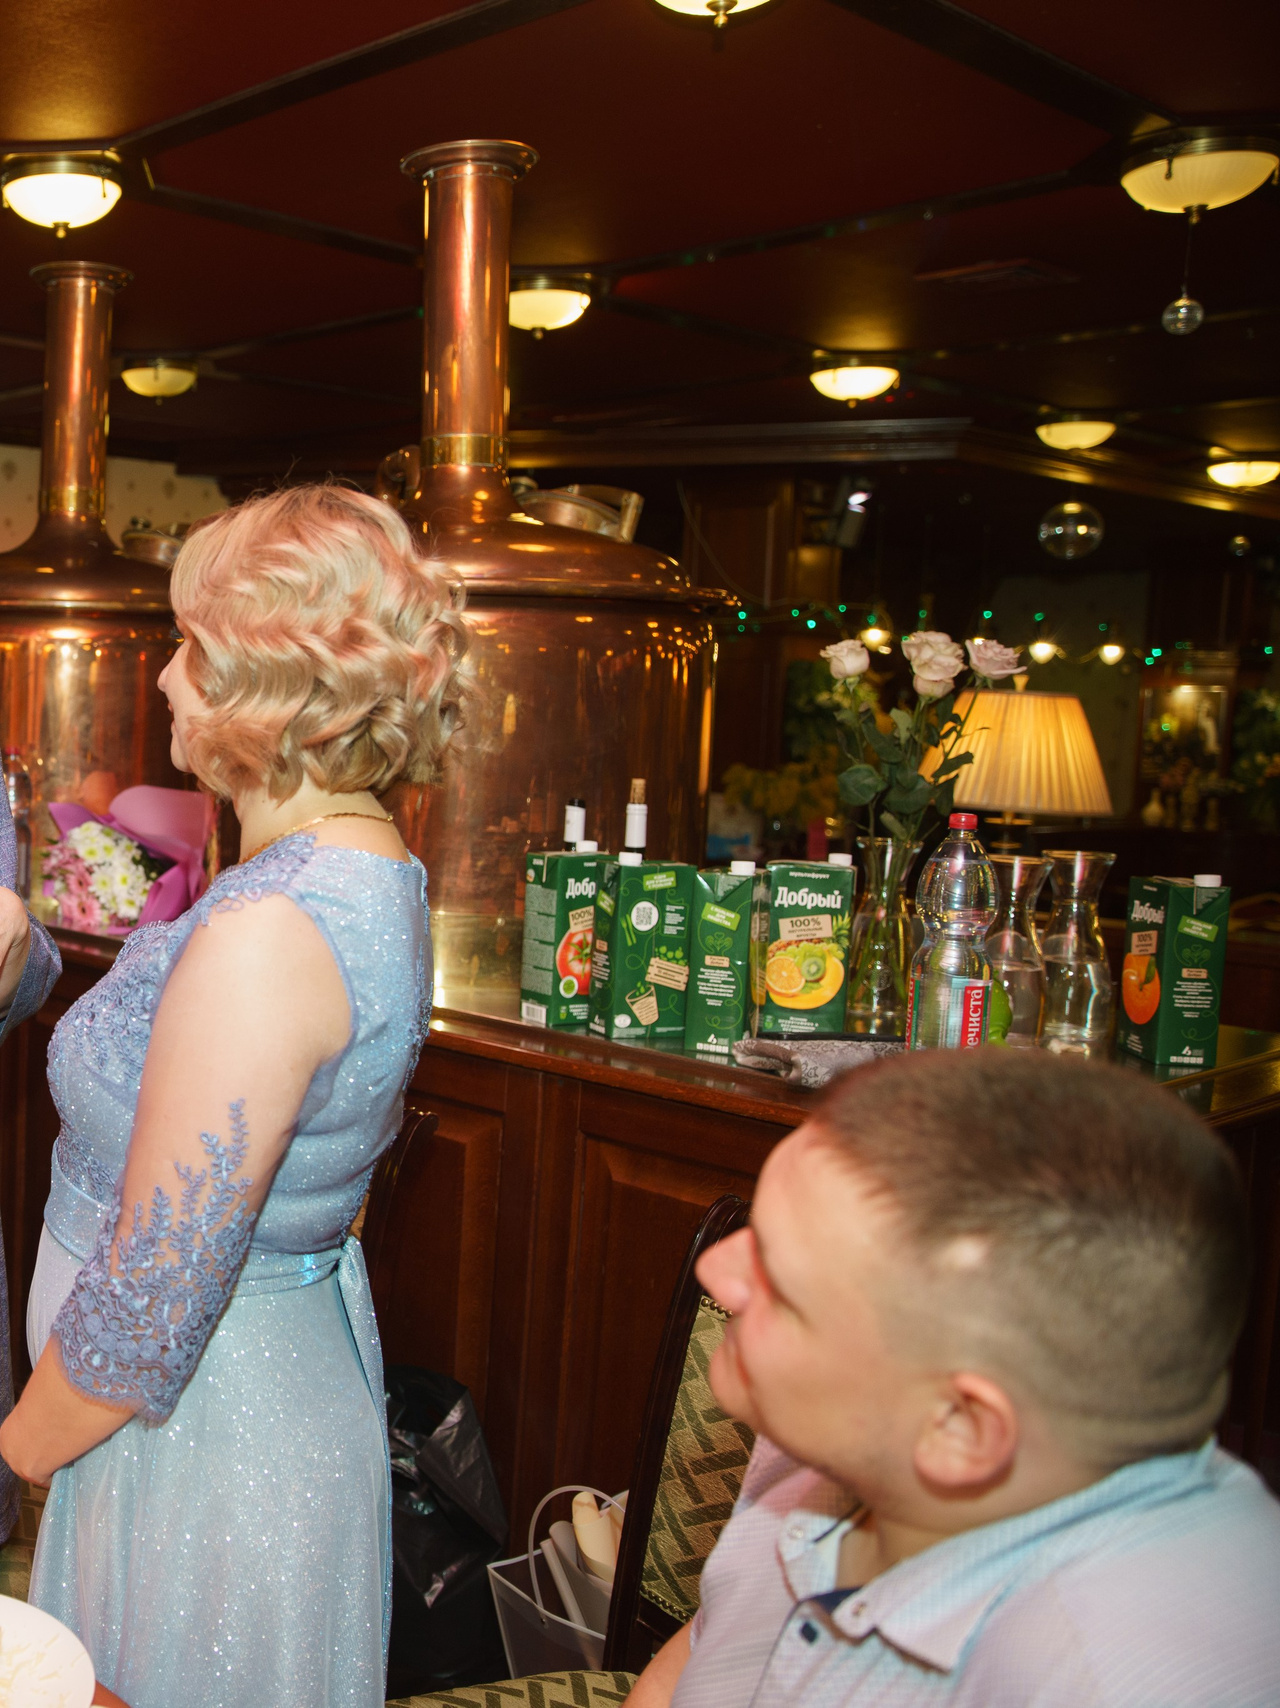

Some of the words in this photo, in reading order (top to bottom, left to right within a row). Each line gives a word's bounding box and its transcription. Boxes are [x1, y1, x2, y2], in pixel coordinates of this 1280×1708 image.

[565, 877, 596, 899] Добр
[774, 886, 842, 910] Добрый
[571, 908, 593, 921] 100%
[789, 917, 821, 928] 100%
[1131, 899, 1165, 924] Добрый
[965, 989, 984, 1048] ечиста
